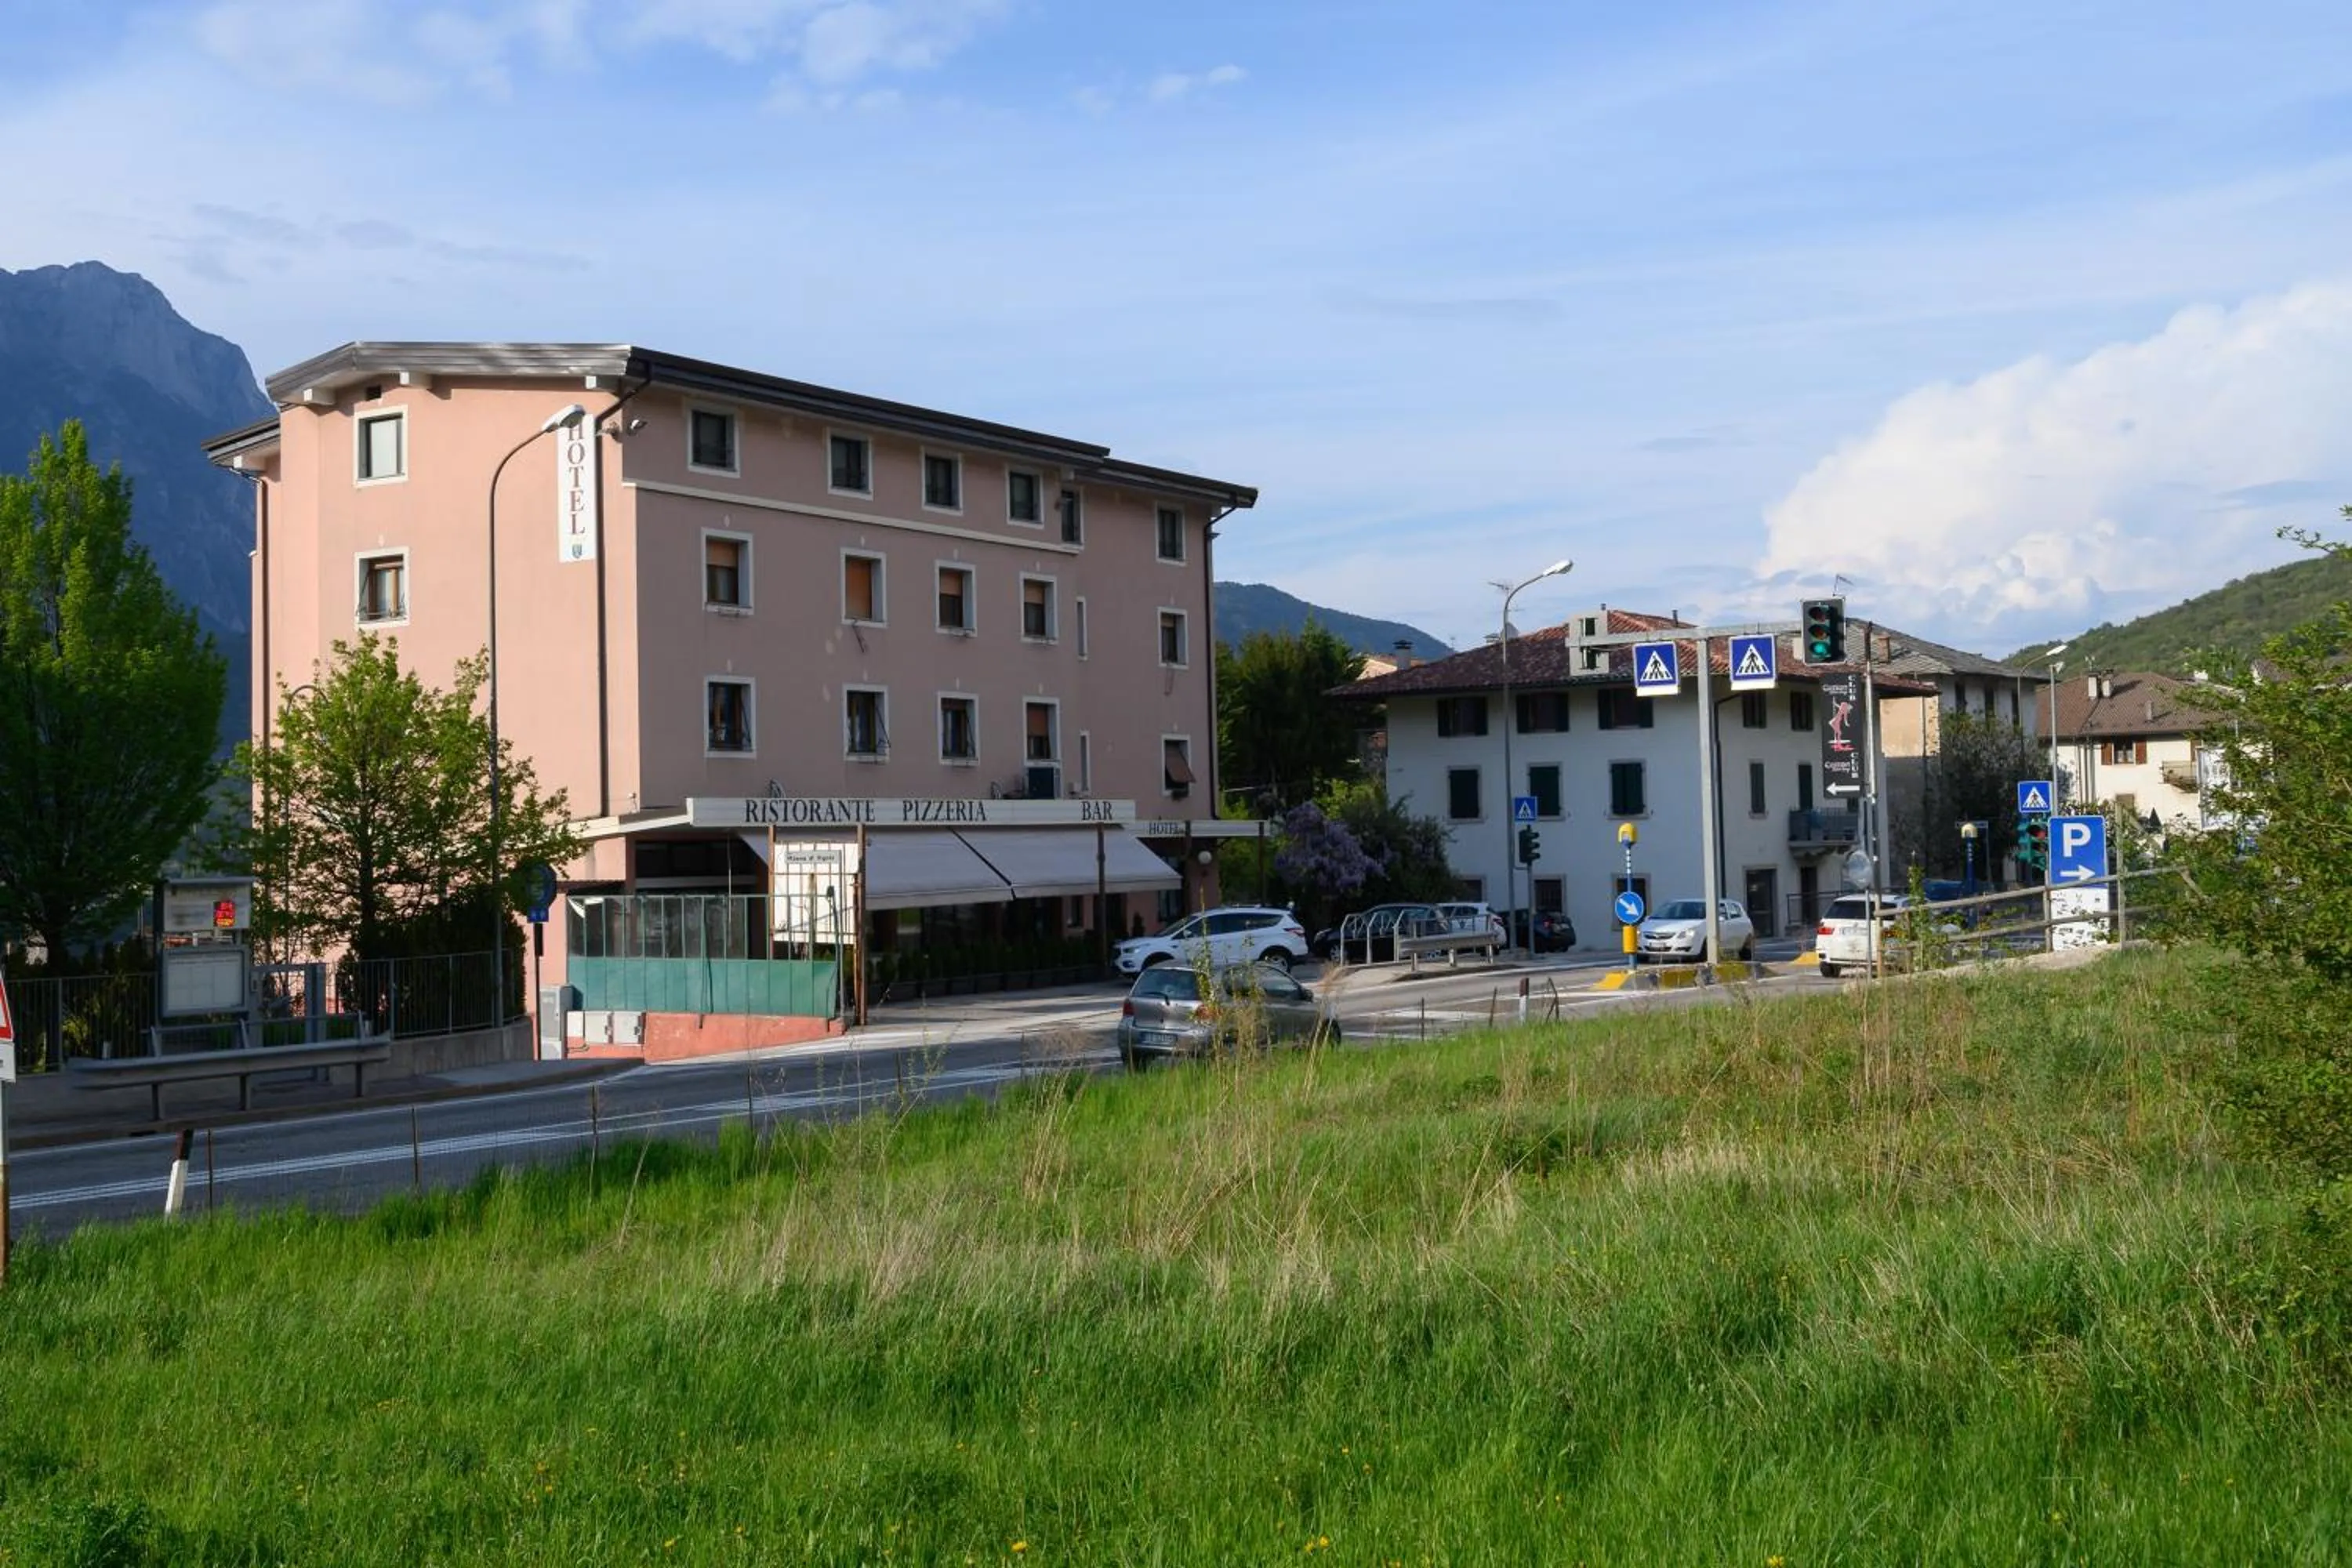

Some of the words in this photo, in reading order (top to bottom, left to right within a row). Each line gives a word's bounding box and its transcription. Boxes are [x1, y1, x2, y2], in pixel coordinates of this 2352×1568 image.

[746, 799, 876, 822] RISTORANTE
[902, 800, 986, 822] PIZZERIA
[1081, 800, 1113, 821] BAR
[2062, 822, 2092, 858] P
